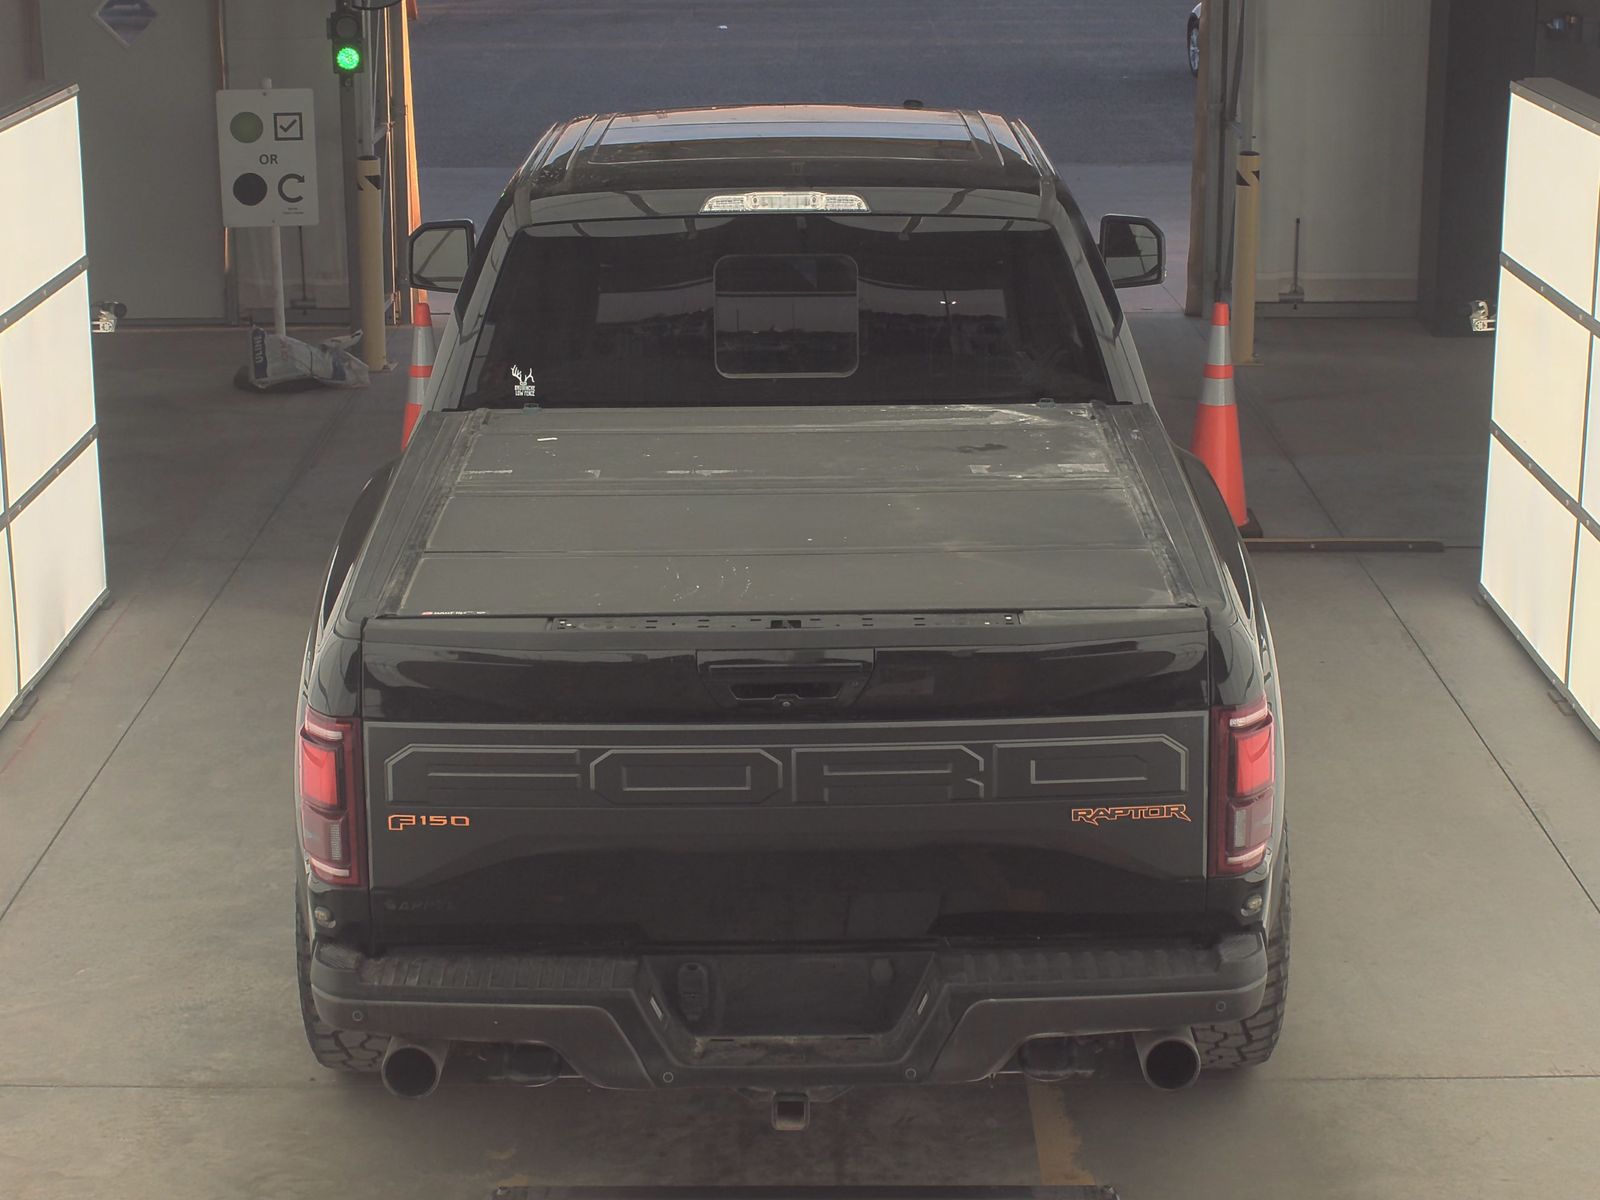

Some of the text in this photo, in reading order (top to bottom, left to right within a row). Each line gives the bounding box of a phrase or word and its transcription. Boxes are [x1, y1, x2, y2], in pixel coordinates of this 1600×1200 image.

[259, 154, 278, 165] OR
[384, 733, 1190, 806] FORD
[1071, 804, 1192, 826] RAPTOR
